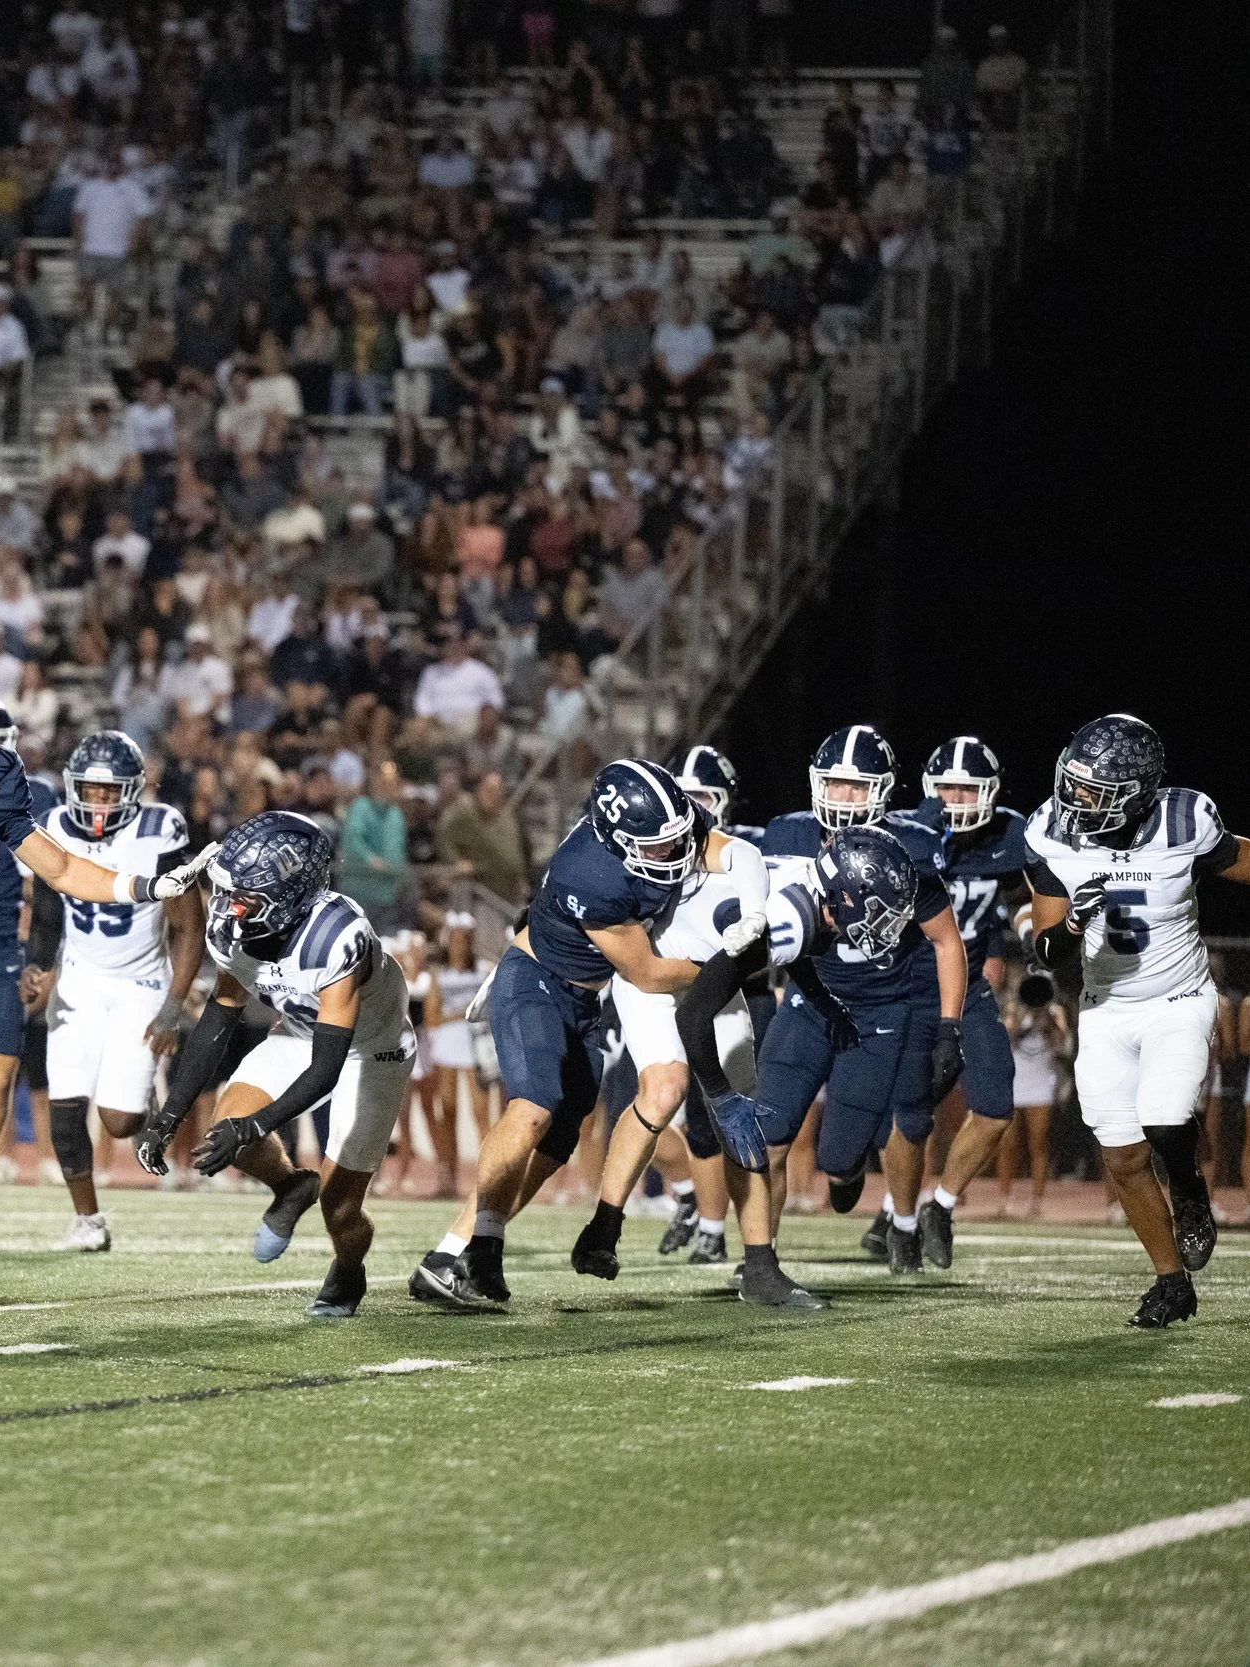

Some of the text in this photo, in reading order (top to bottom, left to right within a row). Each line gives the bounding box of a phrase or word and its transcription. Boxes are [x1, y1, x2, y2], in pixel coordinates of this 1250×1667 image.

[597, 784, 629, 824] 25
[566, 894, 587, 920] SV
[1104, 888, 1151, 955] 5
